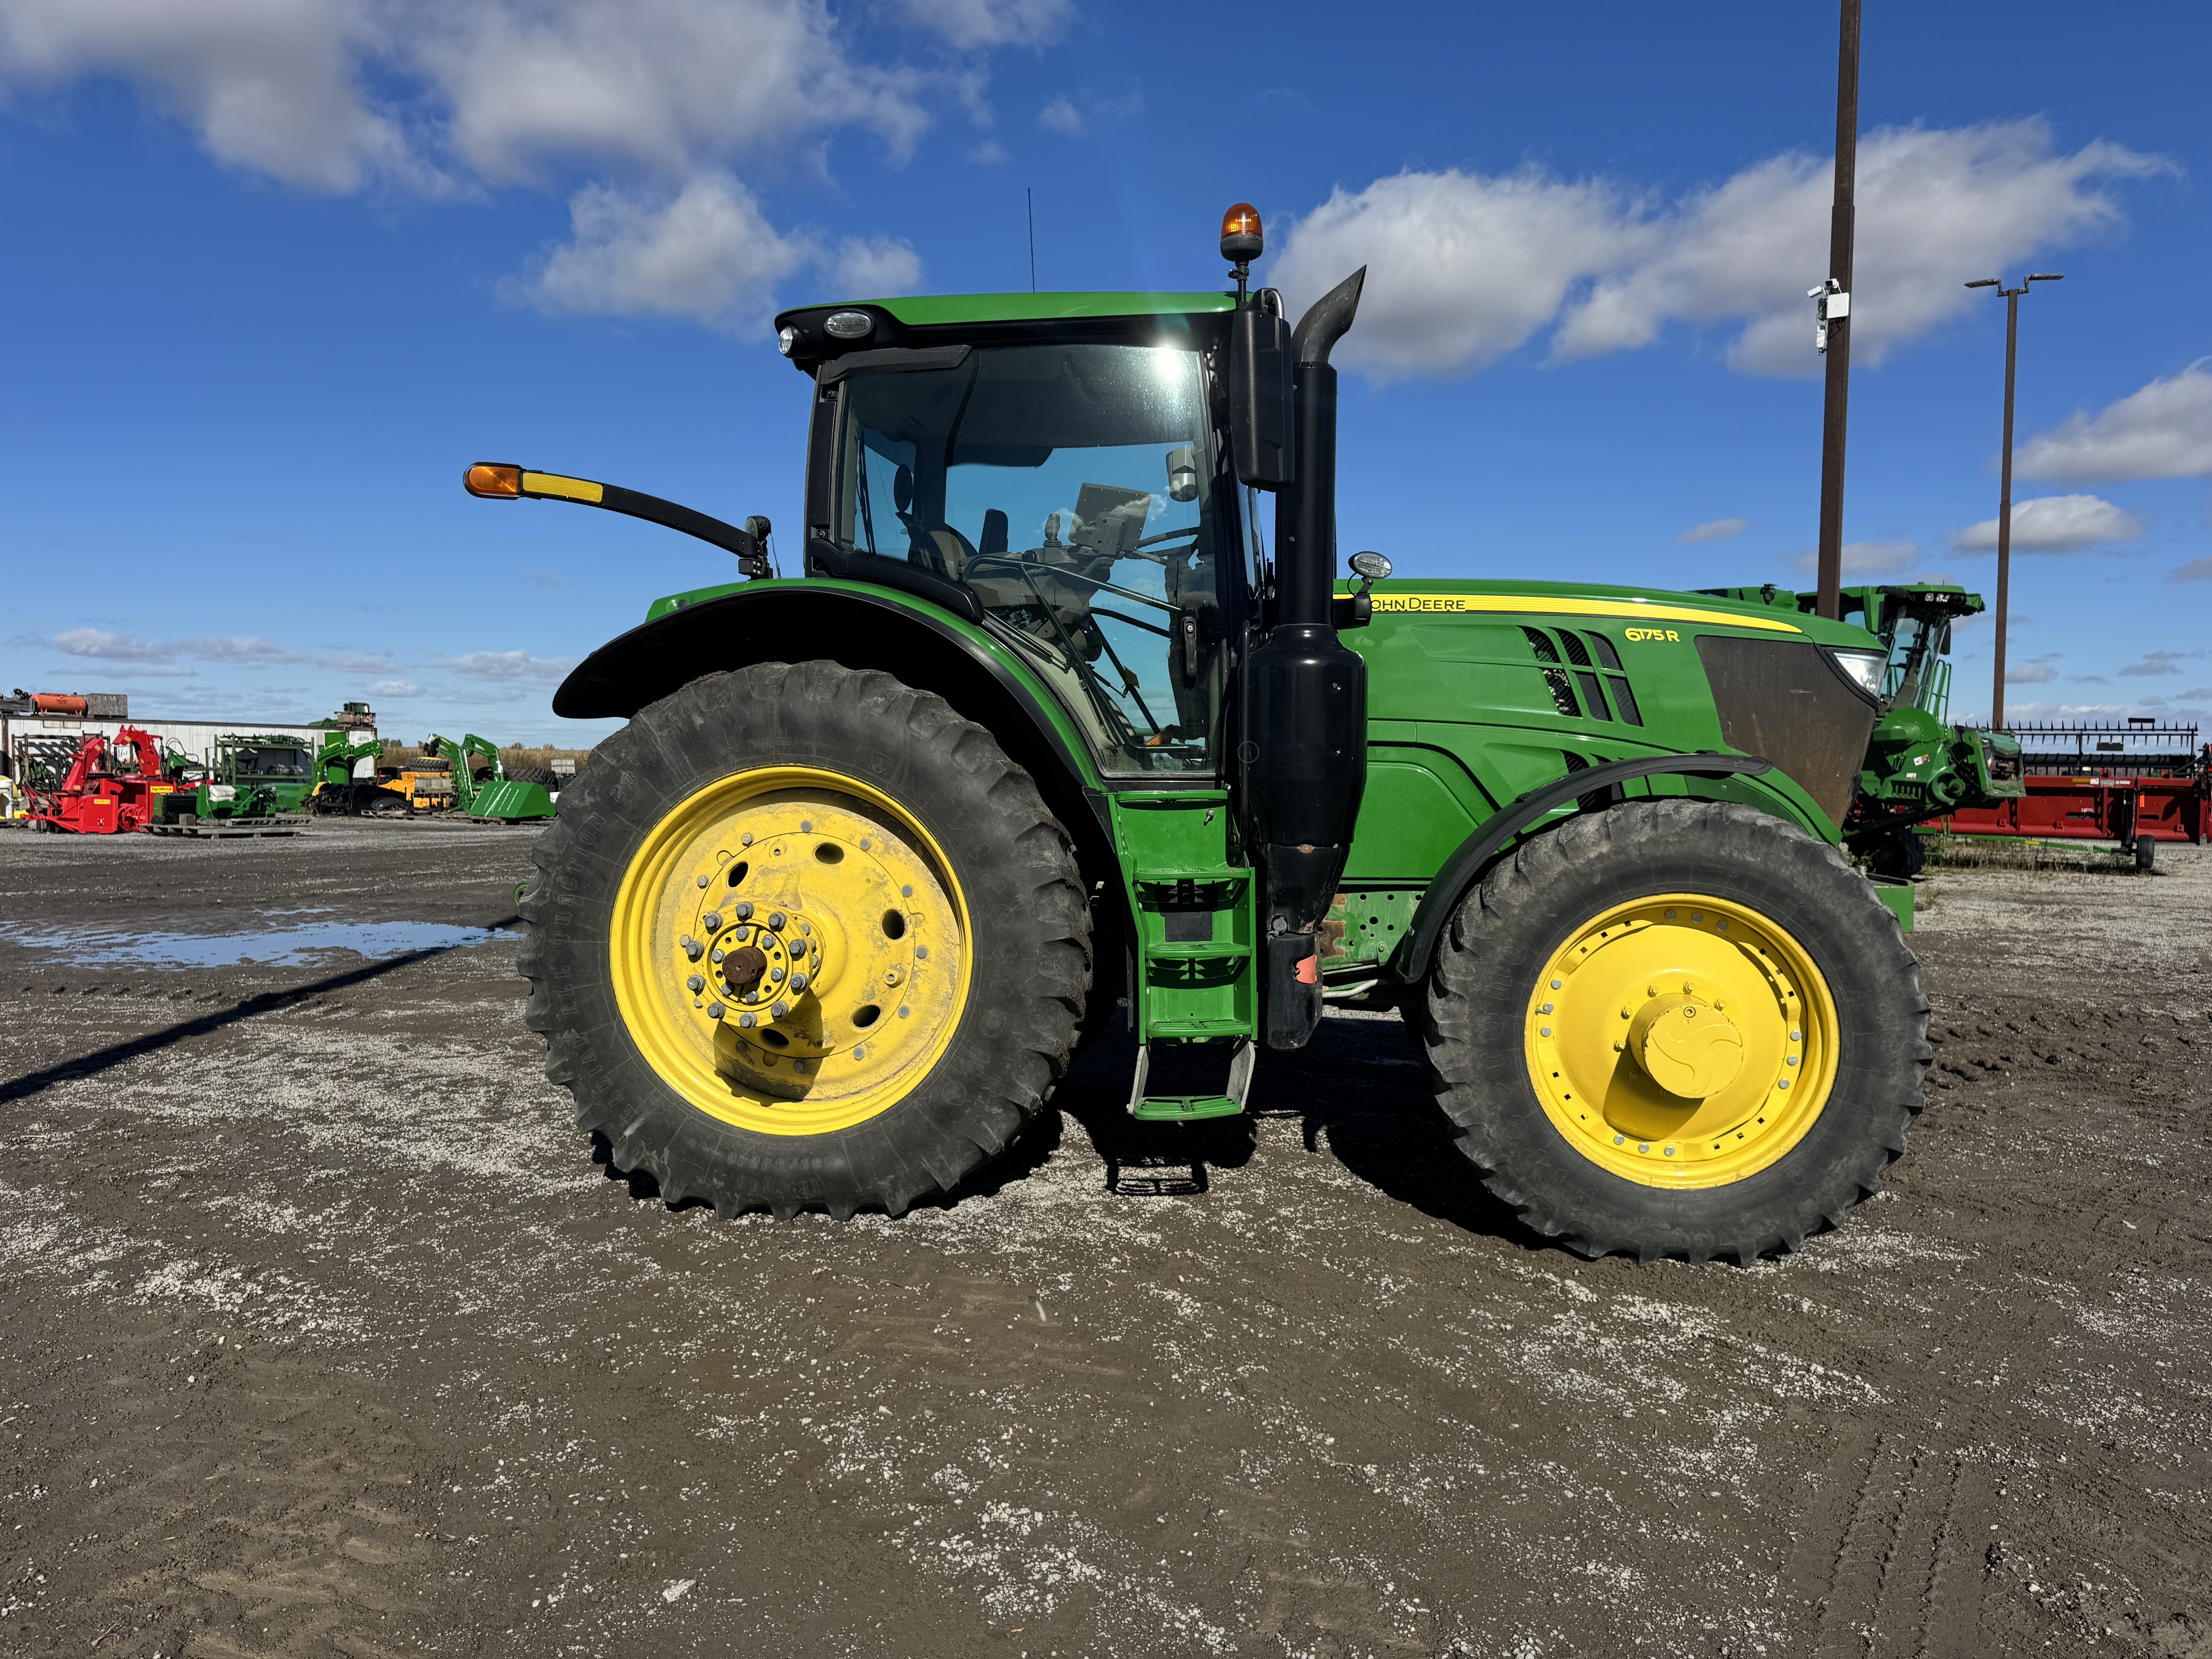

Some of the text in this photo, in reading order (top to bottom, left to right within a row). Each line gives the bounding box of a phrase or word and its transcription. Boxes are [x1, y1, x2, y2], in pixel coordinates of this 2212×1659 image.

[1371, 598, 1465, 610] OHN DEERE
[1625, 627, 1680, 642] 6175 R
[554, 770, 639, 1125] RADIAL ALL TRACTION 23
